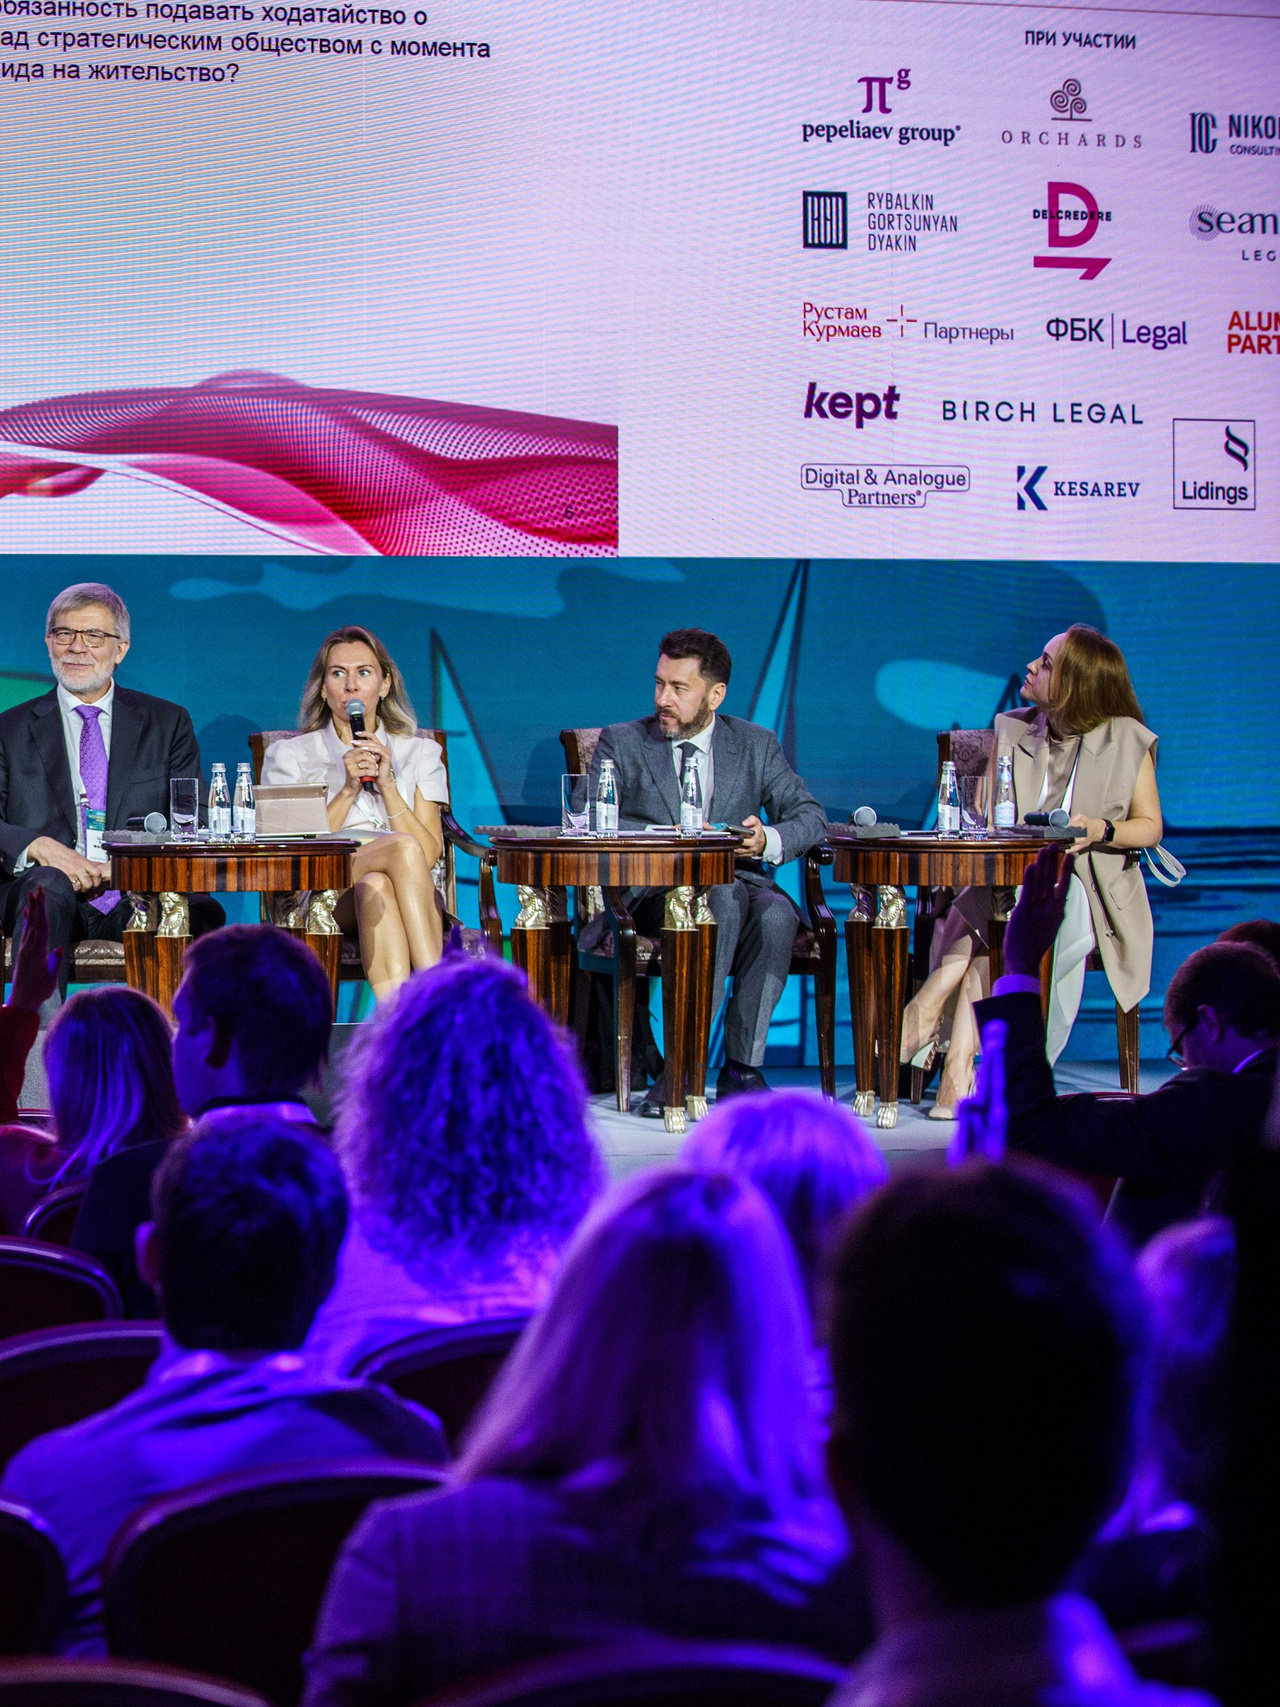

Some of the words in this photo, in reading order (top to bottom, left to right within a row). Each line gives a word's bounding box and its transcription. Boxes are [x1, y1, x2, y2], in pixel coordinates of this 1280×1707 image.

[146, 2, 254, 23] подавать
[261, 3, 406, 25] ходатайство
[414, 11, 427, 25] о
[37, 31, 222, 52] стратегическим
[231, 32, 363, 54] обществом
[370, 38, 383, 55] с
[390, 38, 491, 58] момента
[1024, 30, 1056, 47] ПРИ
[1062, 32, 1137, 50] УЧАСТИИ
[53, 63, 80, 79] на
[88, 62, 240, 83] жительство?
[802, 120, 893, 142] pepeliaev
[1228, 113, 1280, 140] NIKO
[1001, 130, 1142, 149] ORCHARDS
[867, 193, 934, 211] RYBALKIN
[868, 214, 958, 233] GORTSUNYAN
[1033, 209, 1112, 221] DELCREDERE
[868, 234, 917, 252] DYAKIN
[1241, 249, 1277, 262] LEG
[802, 302, 868, 322] Рустам
[802, 320, 882, 342] Курмаев
[924, 322, 1015, 344] Партнеры
[1045, 317, 1105, 343] ФБК
[1122, 319, 1188, 350] Legal
[1228, 333, 1280, 355] PART
[804, 382, 900, 428] kept
[942, 400, 1036, 423] BIRCH
[1053, 402, 1144, 425] LEGAL
[805, 468, 860, 488] Digital
[864, 468, 878, 486] &
[883, 469, 966, 490] Analogue
[1053, 481, 1140, 497] KESAREV
[1182, 481, 1248, 505] Lidings
[565, 505, 574, 520] 6
